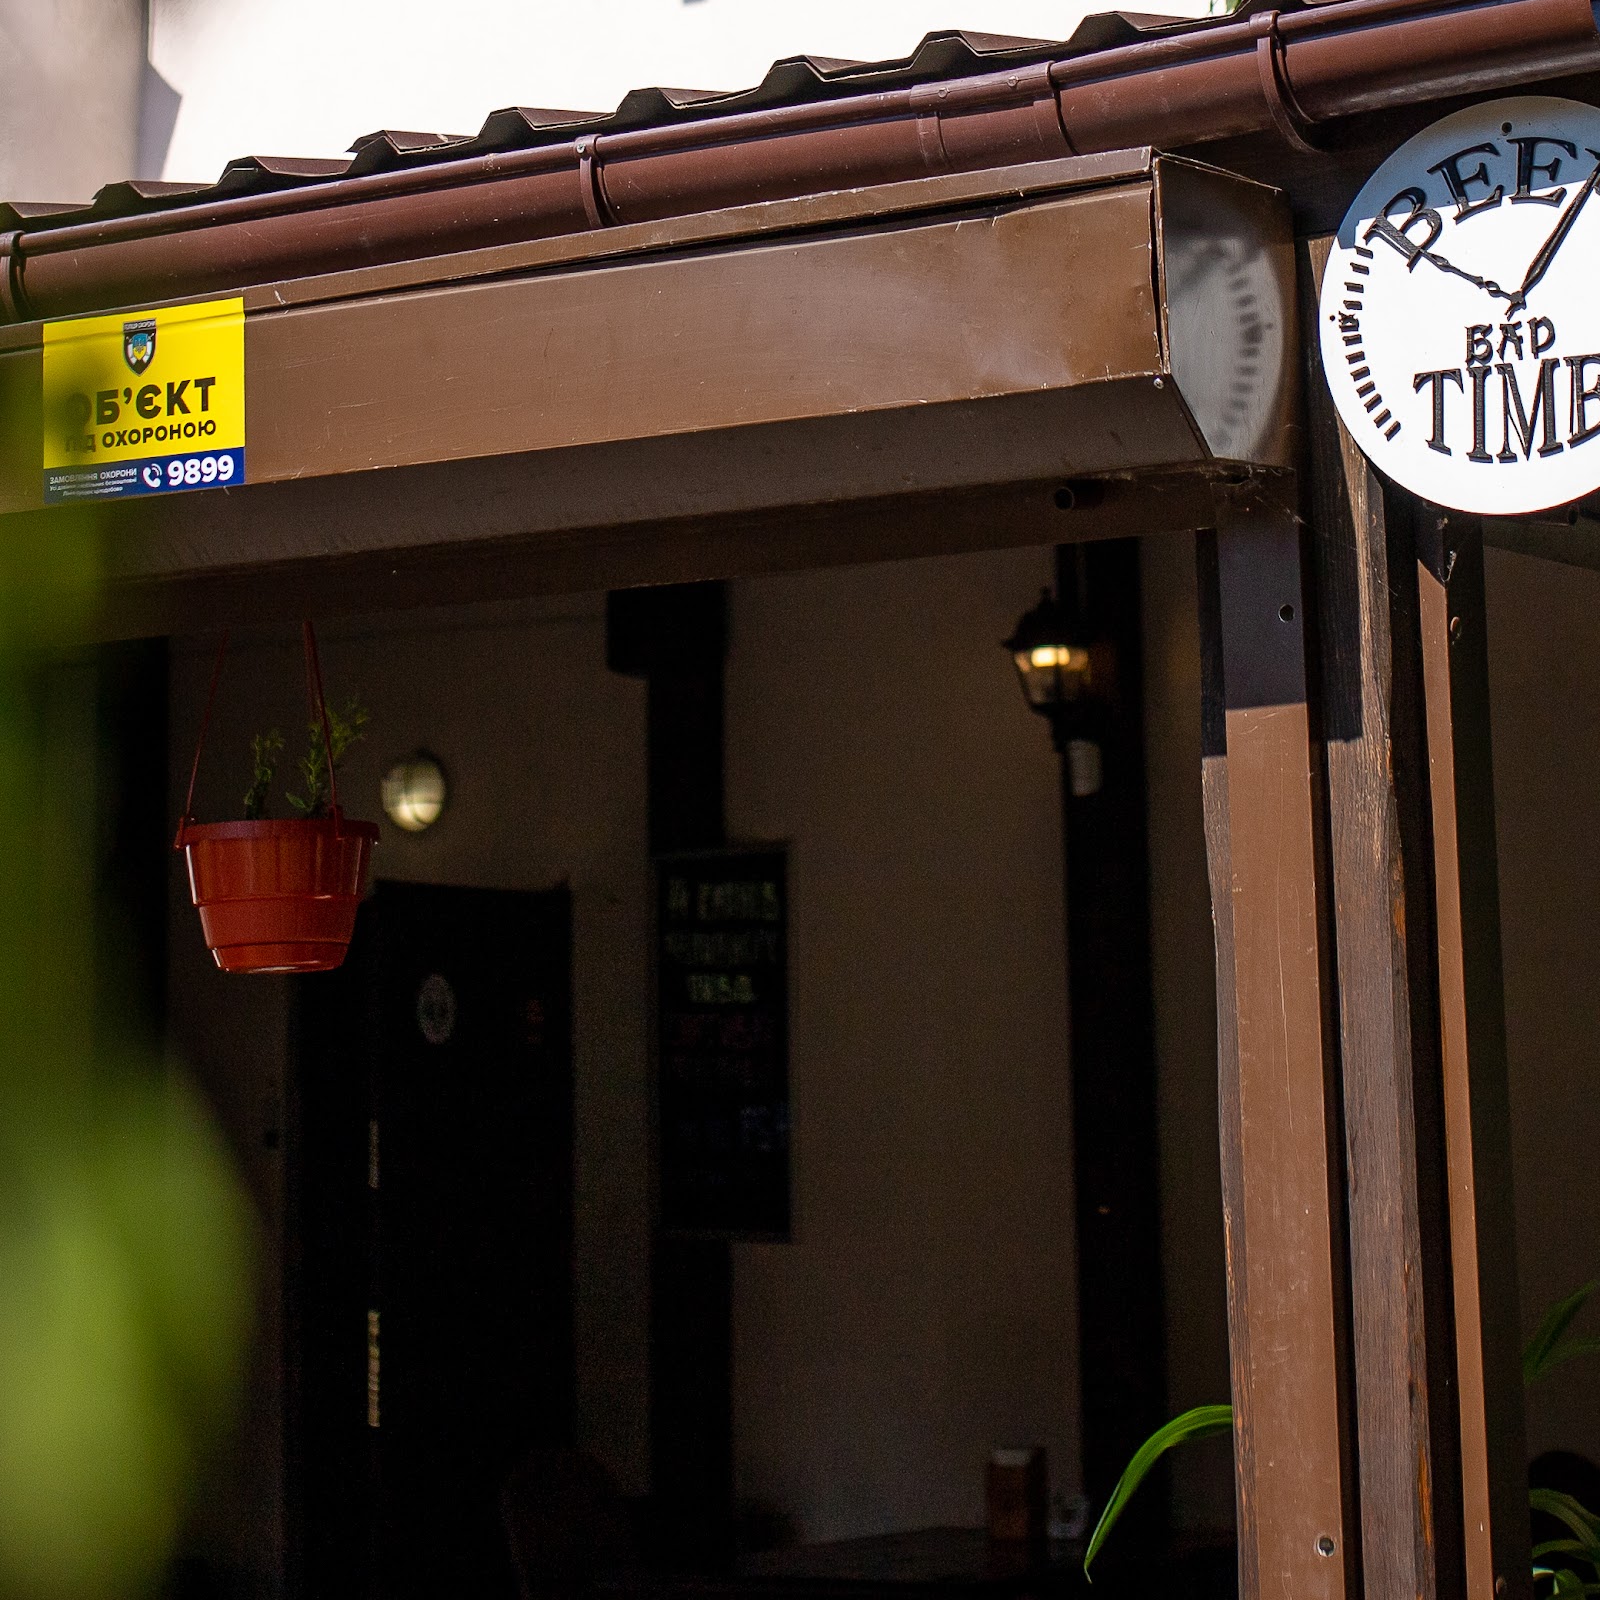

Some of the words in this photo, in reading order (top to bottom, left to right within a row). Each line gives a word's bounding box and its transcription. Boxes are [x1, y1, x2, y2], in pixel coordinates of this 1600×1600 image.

[64, 433, 97, 454] ПД
[101, 419, 217, 449] ОХОРОНОЮ
[99, 467, 138, 481] ОХОРОНИ
[167, 454, 235, 487] 9899
